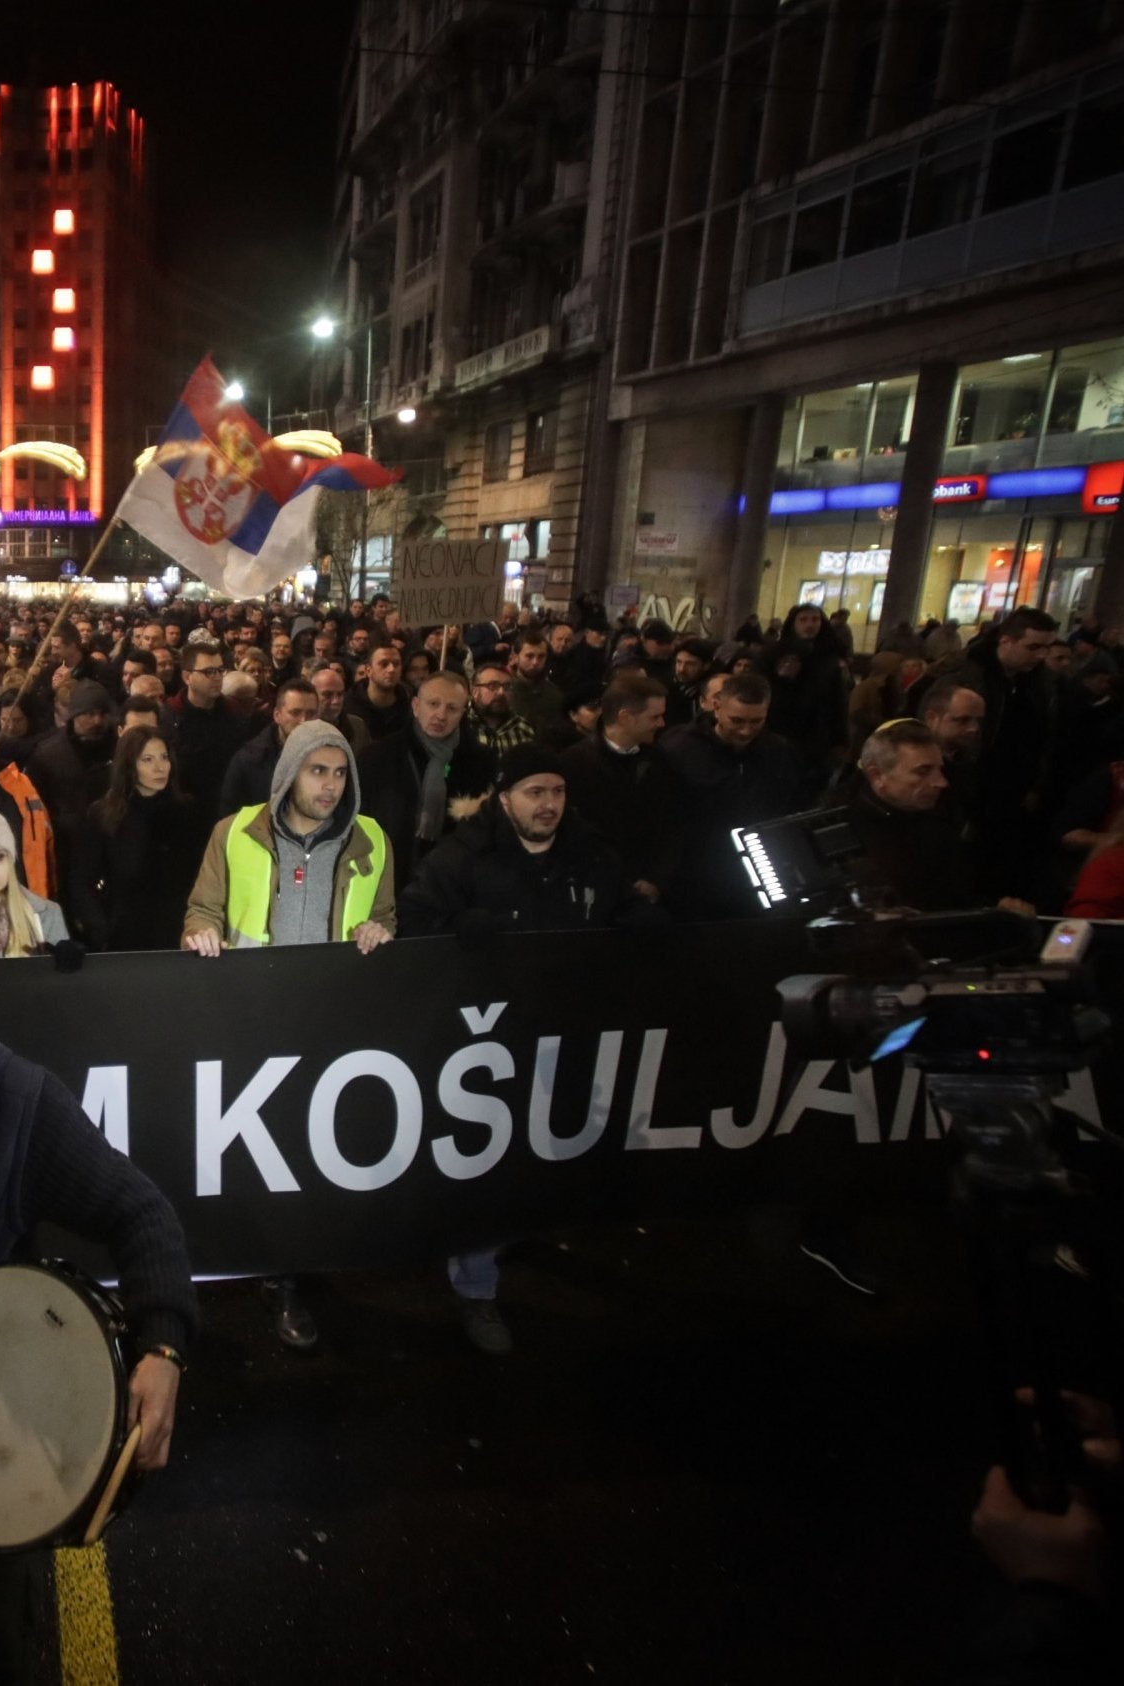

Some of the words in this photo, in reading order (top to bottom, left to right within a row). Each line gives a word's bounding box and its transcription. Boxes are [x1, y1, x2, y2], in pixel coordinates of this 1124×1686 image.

[932, 483, 972, 498] obank
[402, 541, 499, 580] NEONACI
[196, 1002, 1106, 1198] KOŠULJAA
